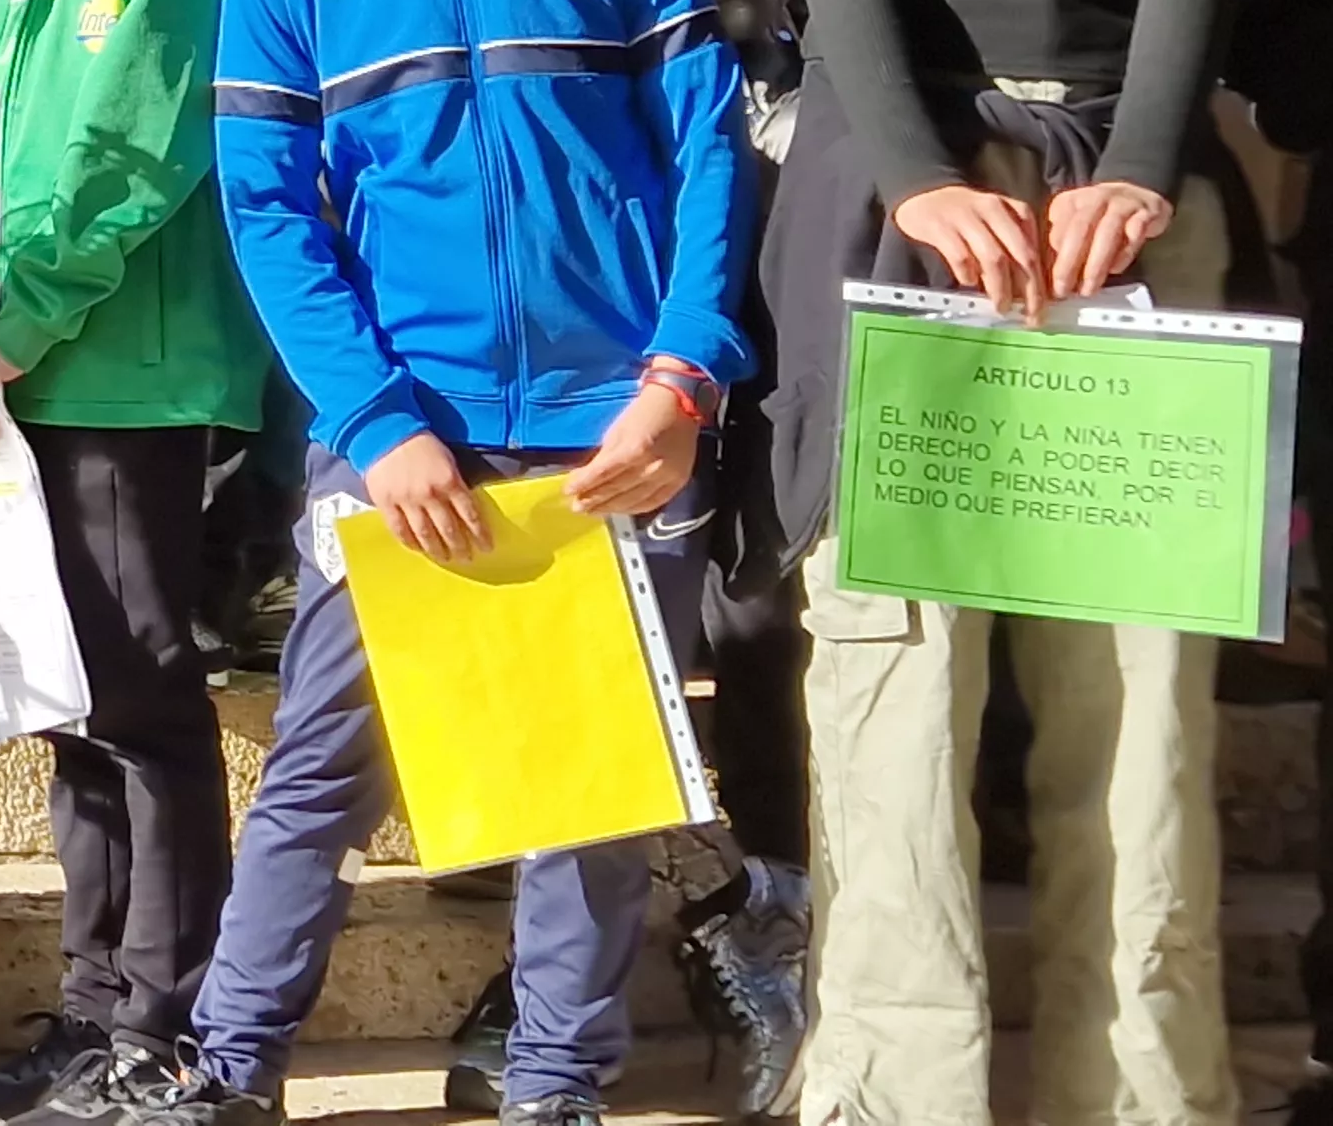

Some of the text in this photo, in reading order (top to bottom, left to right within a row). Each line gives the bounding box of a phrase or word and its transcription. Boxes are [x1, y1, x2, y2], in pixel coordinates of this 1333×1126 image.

[1106, 378, 1131, 396] 13
[879, 405, 1226, 456] EL NIÑO Y LA NIÑA TIENEN
[877, 431, 1226, 483] DERECHO A PODER DECIR
[874, 483, 1152, 529] MEDIO QUE PREFIERAN
[876, 457, 907, 477] LO
[923, 463, 973, 485] QUE
[1123, 483, 1174, 505] POR
[1195, 490, 1223, 509] EL
